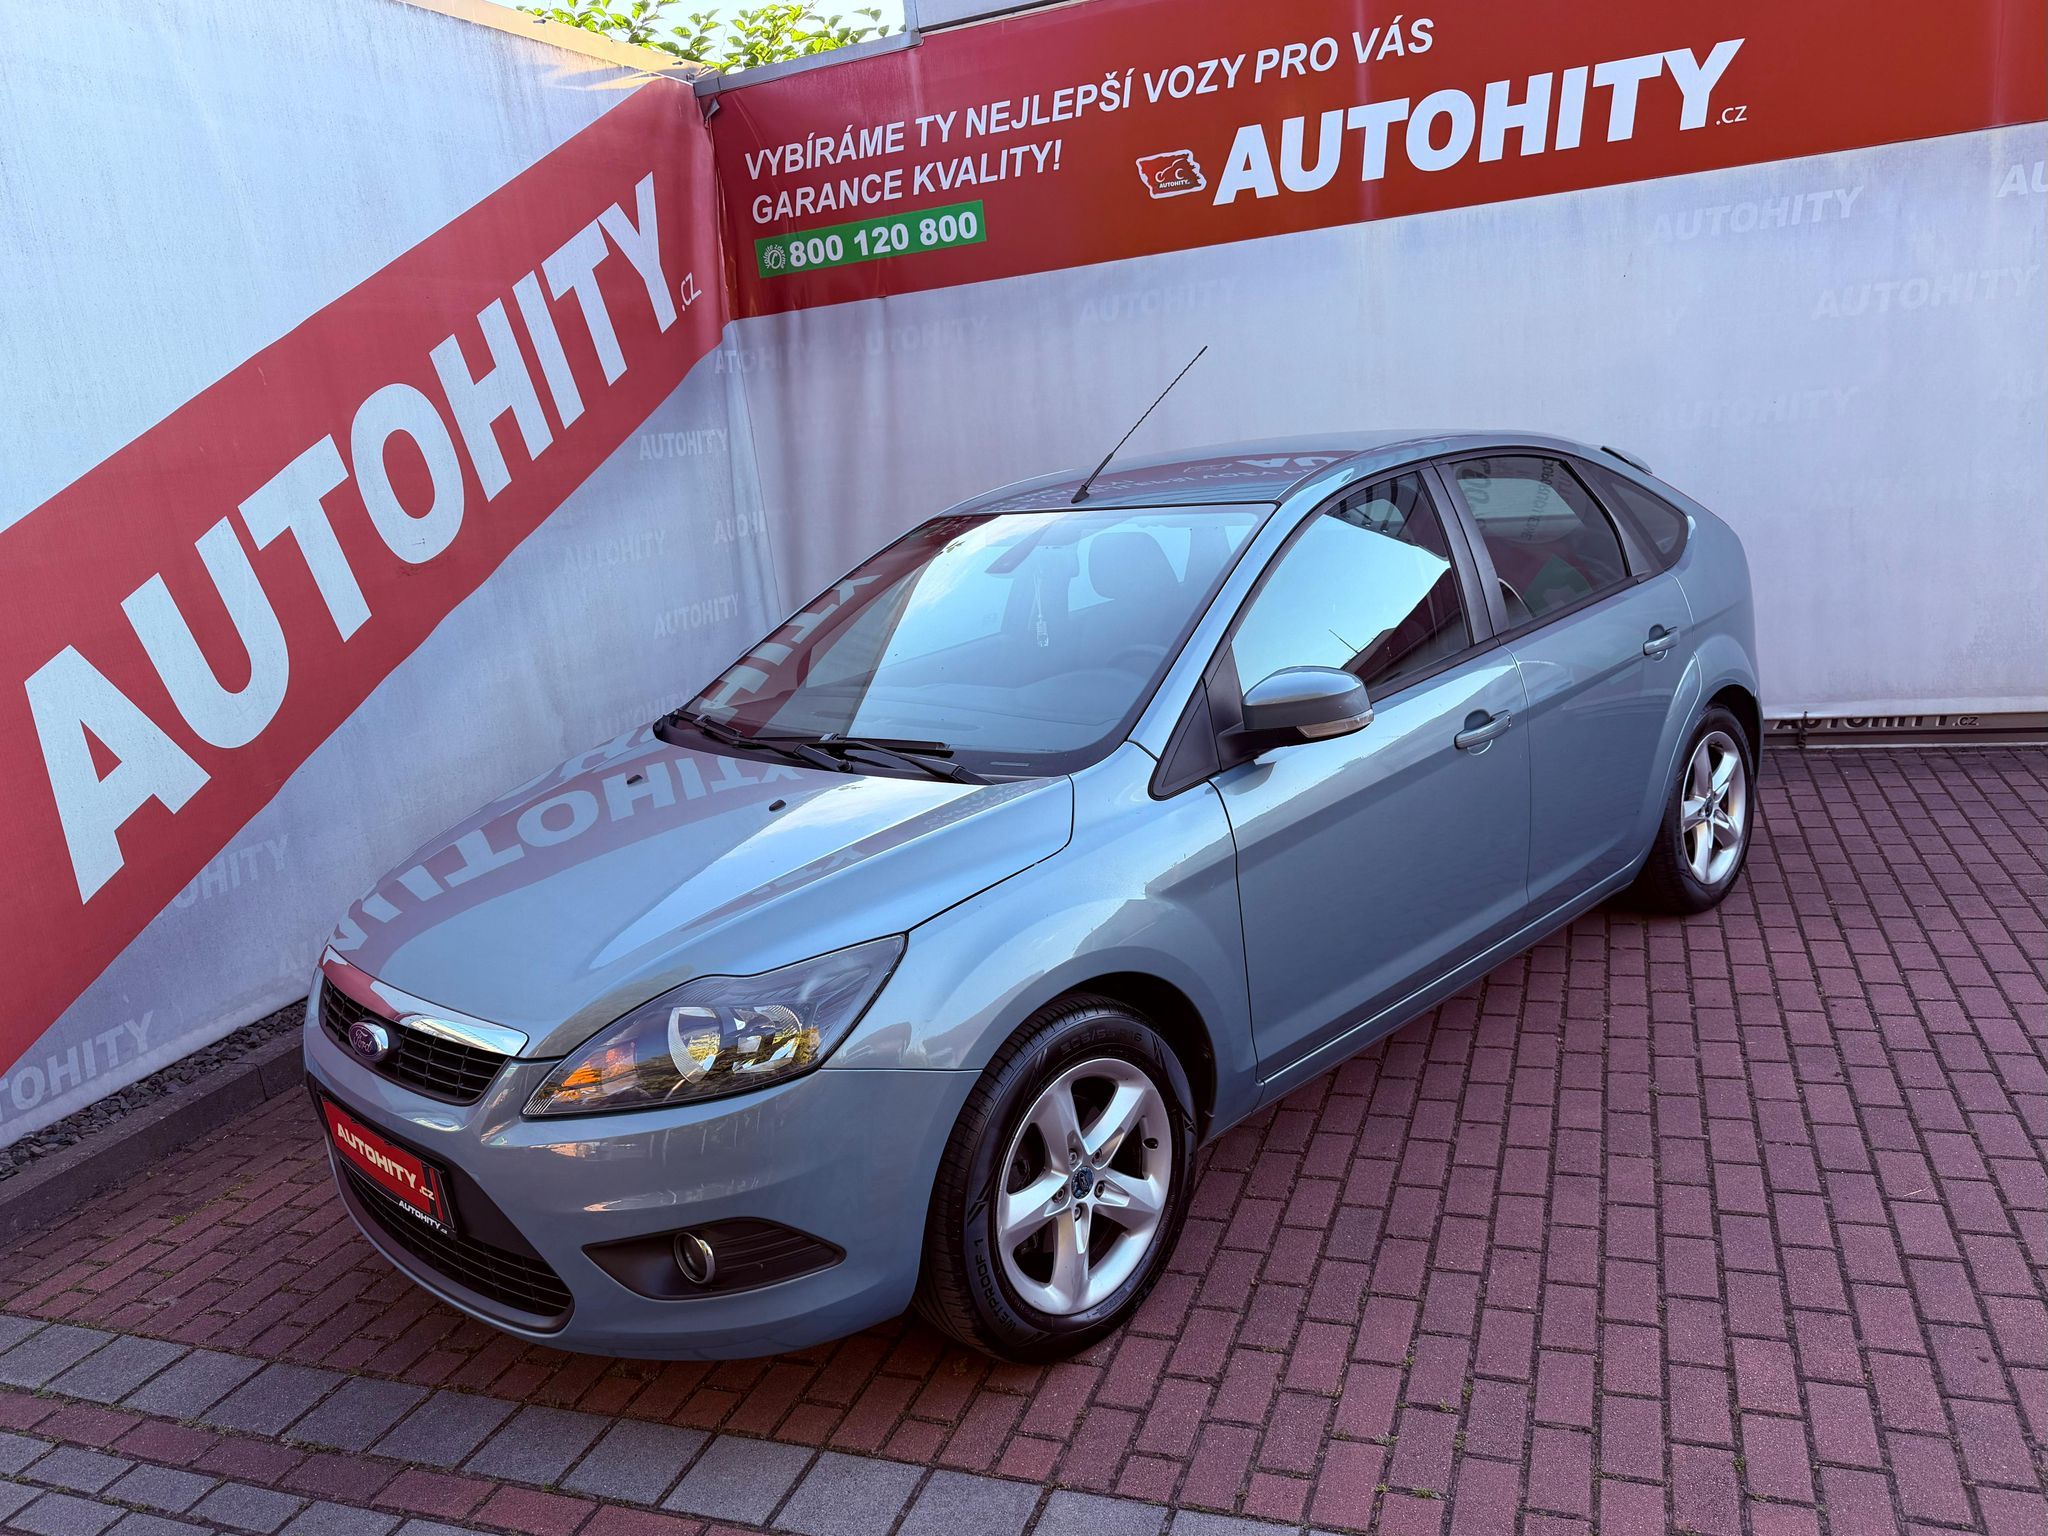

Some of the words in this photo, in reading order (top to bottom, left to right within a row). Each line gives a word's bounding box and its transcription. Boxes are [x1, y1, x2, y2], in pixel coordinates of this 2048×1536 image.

[745, 117, 905, 182] VYBÍRÁME
[915, 107, 958, 149] TY
[965, 68, 1133, 140] NEJLEPŠÍ
[1144, 54, 1245, 106] VOZY
[1255, 37, 1338, 83] PRO
[1353, 16, 1435, 66] VÁS
[752, 170, 904, 225] GARANCE
[913, 139, 1063, 195] KVALITY!
[789, 234, 844, 268] 800
[853, 223, 909, 256] 120
[919, 211, 978, 246] 800
[1647, 185, 1864, 246] AUTOHITY
[1811, 264, 2040, 322] AUTOHITY
[638, 428, 729, 461] AUTOHITY
[653, 593, 740, 639] AUTOHITY
[352, 1028, 372, 1053] Ford
